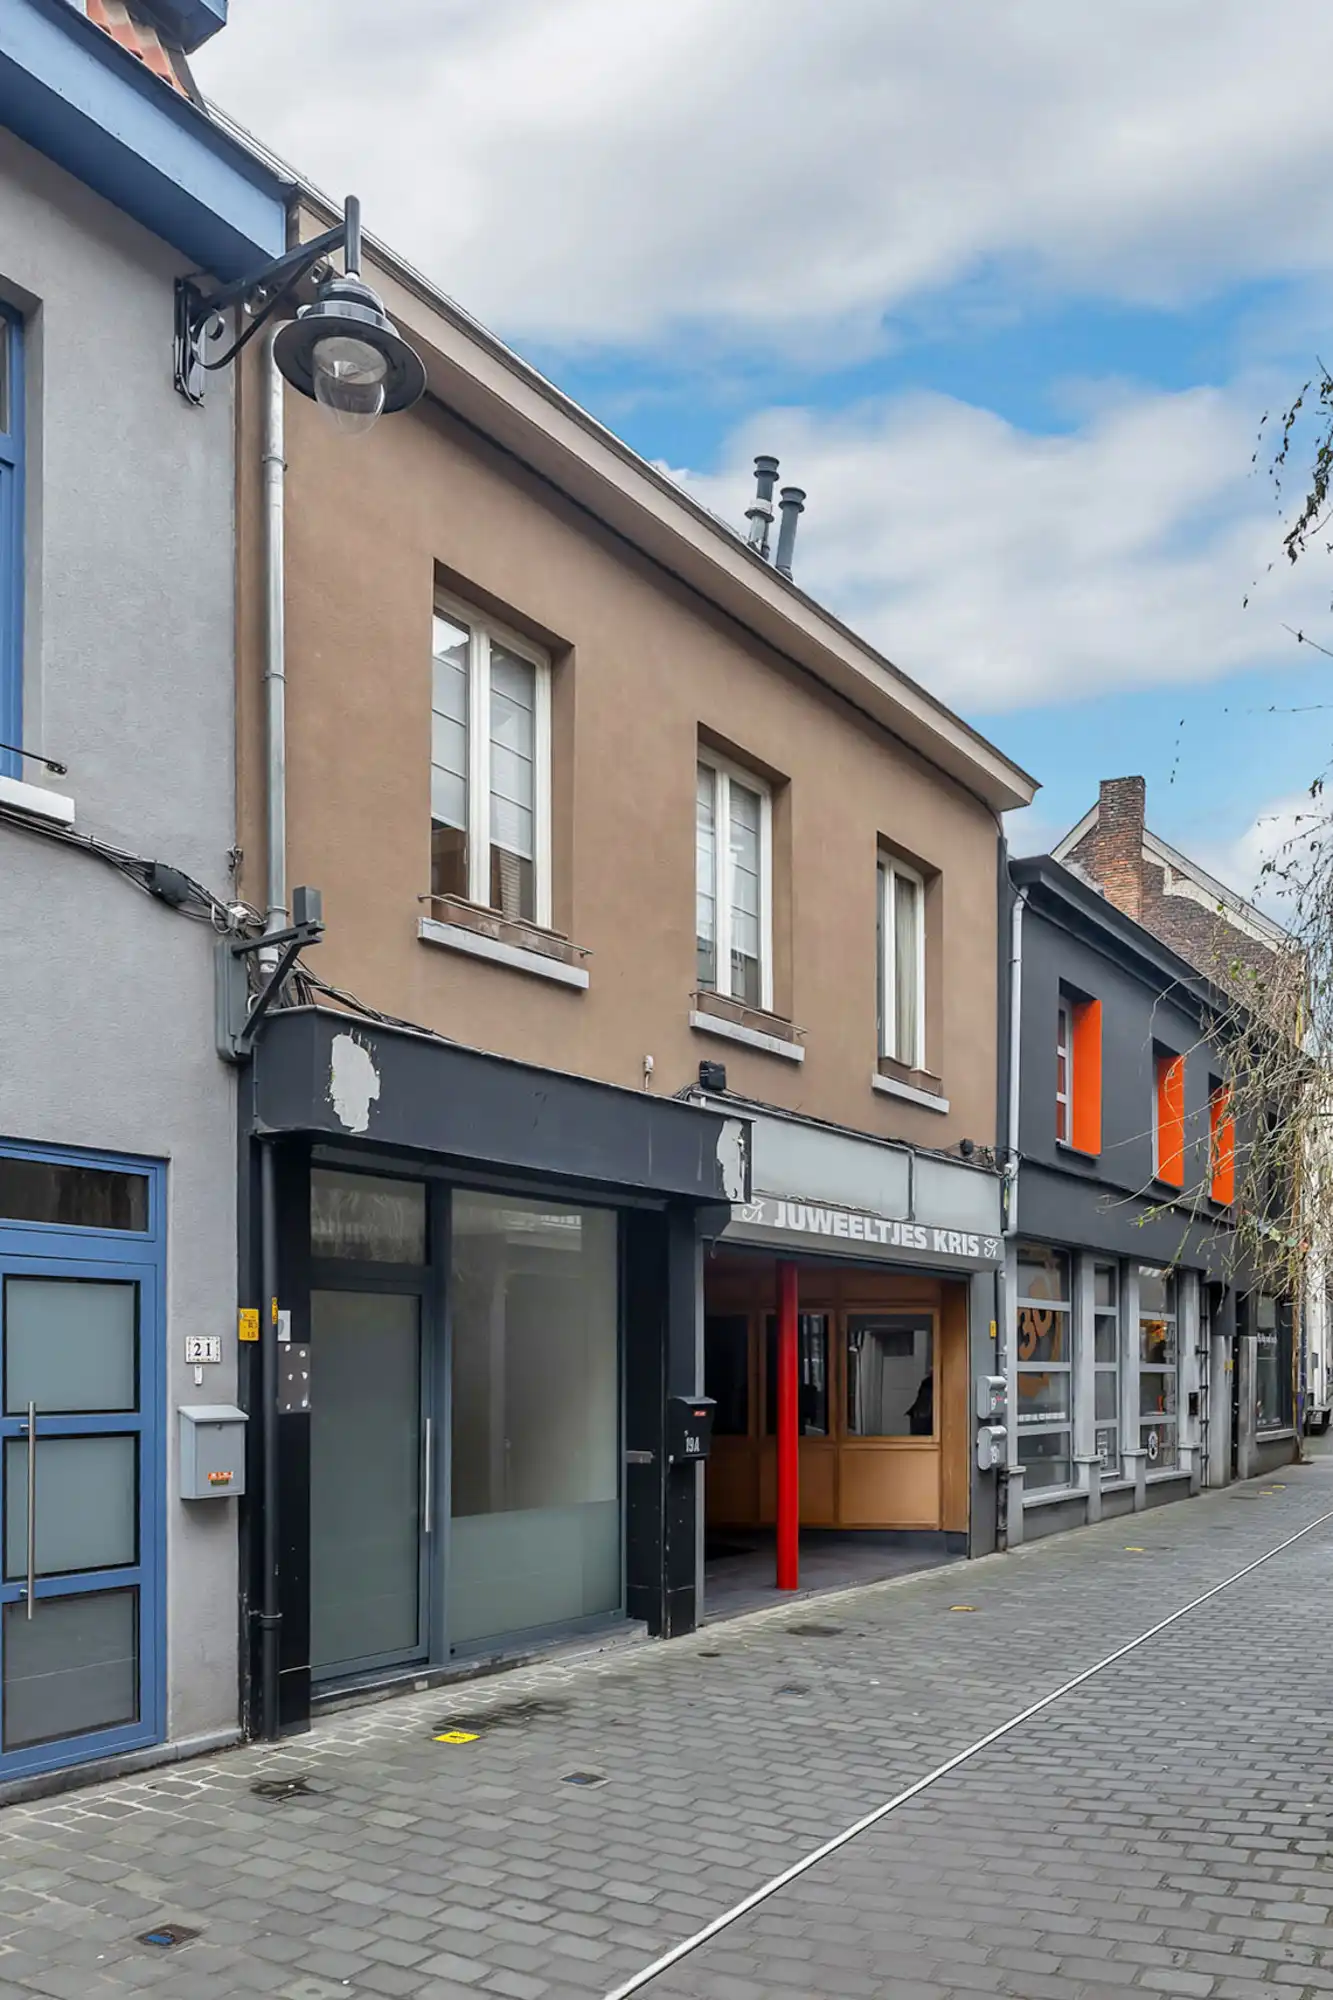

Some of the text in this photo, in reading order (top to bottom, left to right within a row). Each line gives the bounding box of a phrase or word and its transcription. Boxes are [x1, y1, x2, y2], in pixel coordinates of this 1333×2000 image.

[774, 1201, 980, 1257] JUWEELTJES KRIS
[193, 1342, 211, 1357] 21
[685, 1436, 700, 1453] 19A
